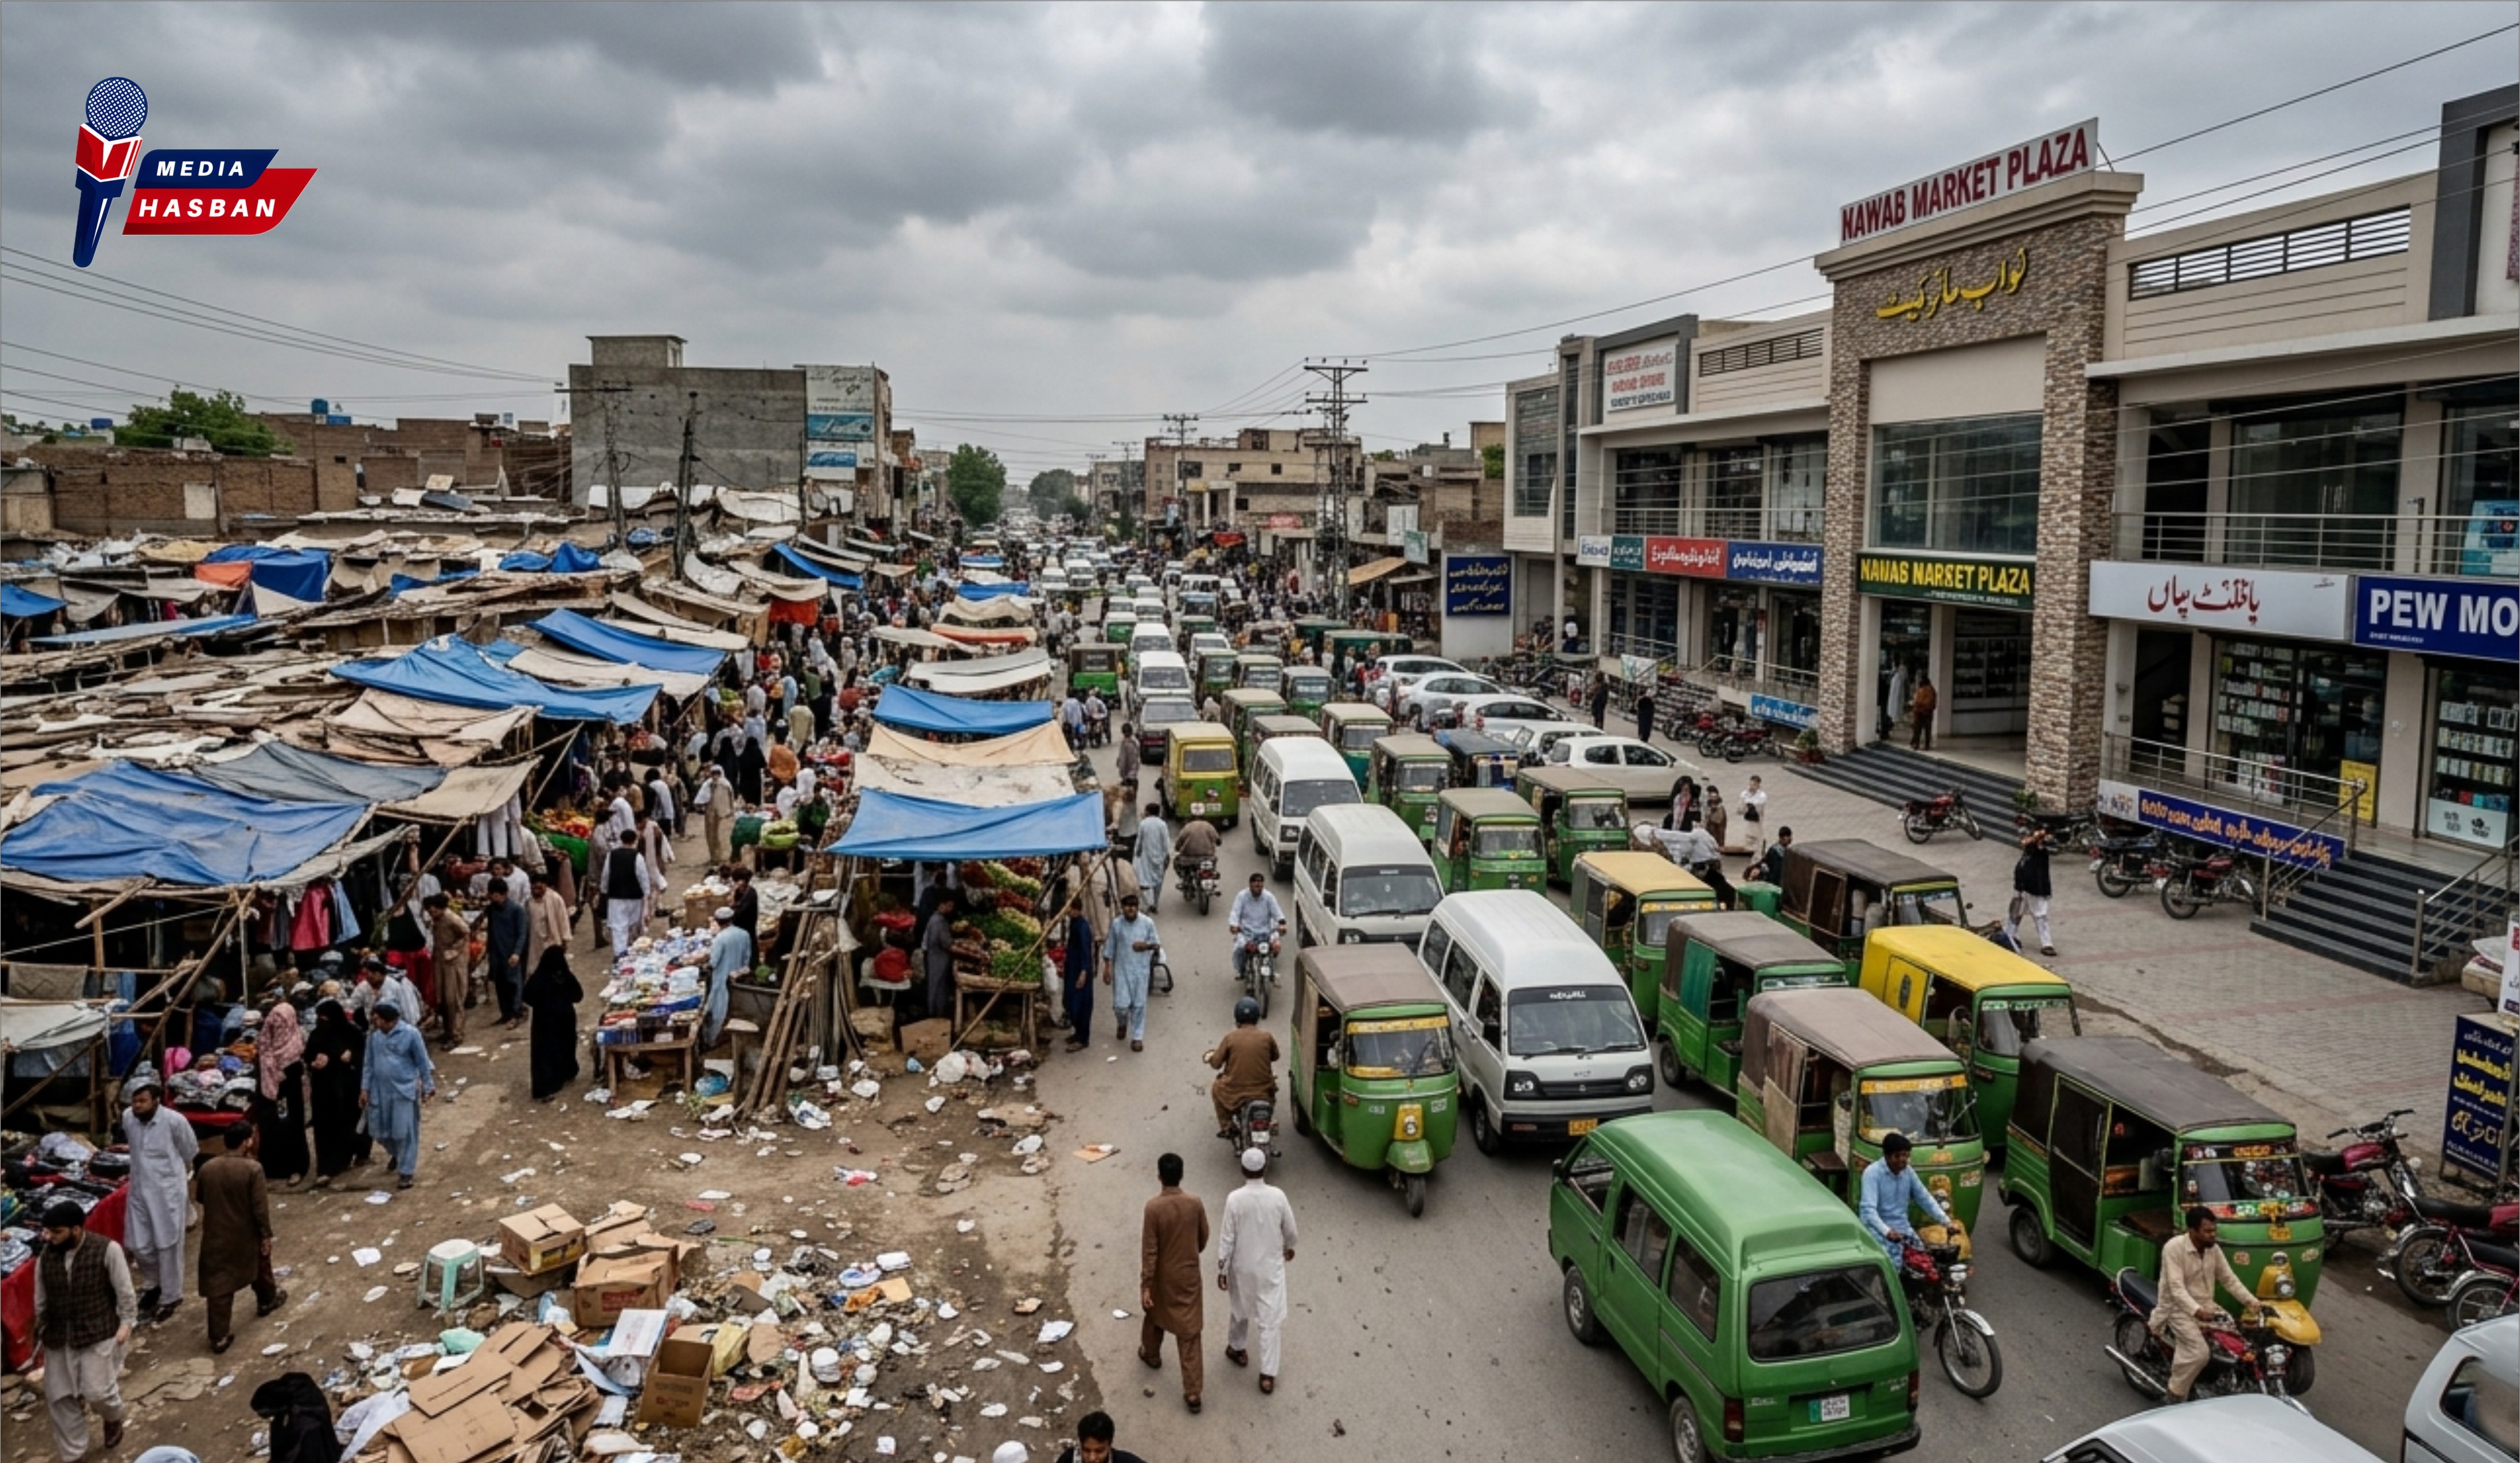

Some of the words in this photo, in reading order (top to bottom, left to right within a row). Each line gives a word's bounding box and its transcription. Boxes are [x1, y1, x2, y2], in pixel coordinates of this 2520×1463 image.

[1842, 190, 1906, 241] NAWAB
[1912, 156, 2001, 220] MARKET
[2008, 128, 2088, 190] PLAZA
[1978, 566, 2030, 595] PLAZA
[2369, 588, 2448, 630] PEW
